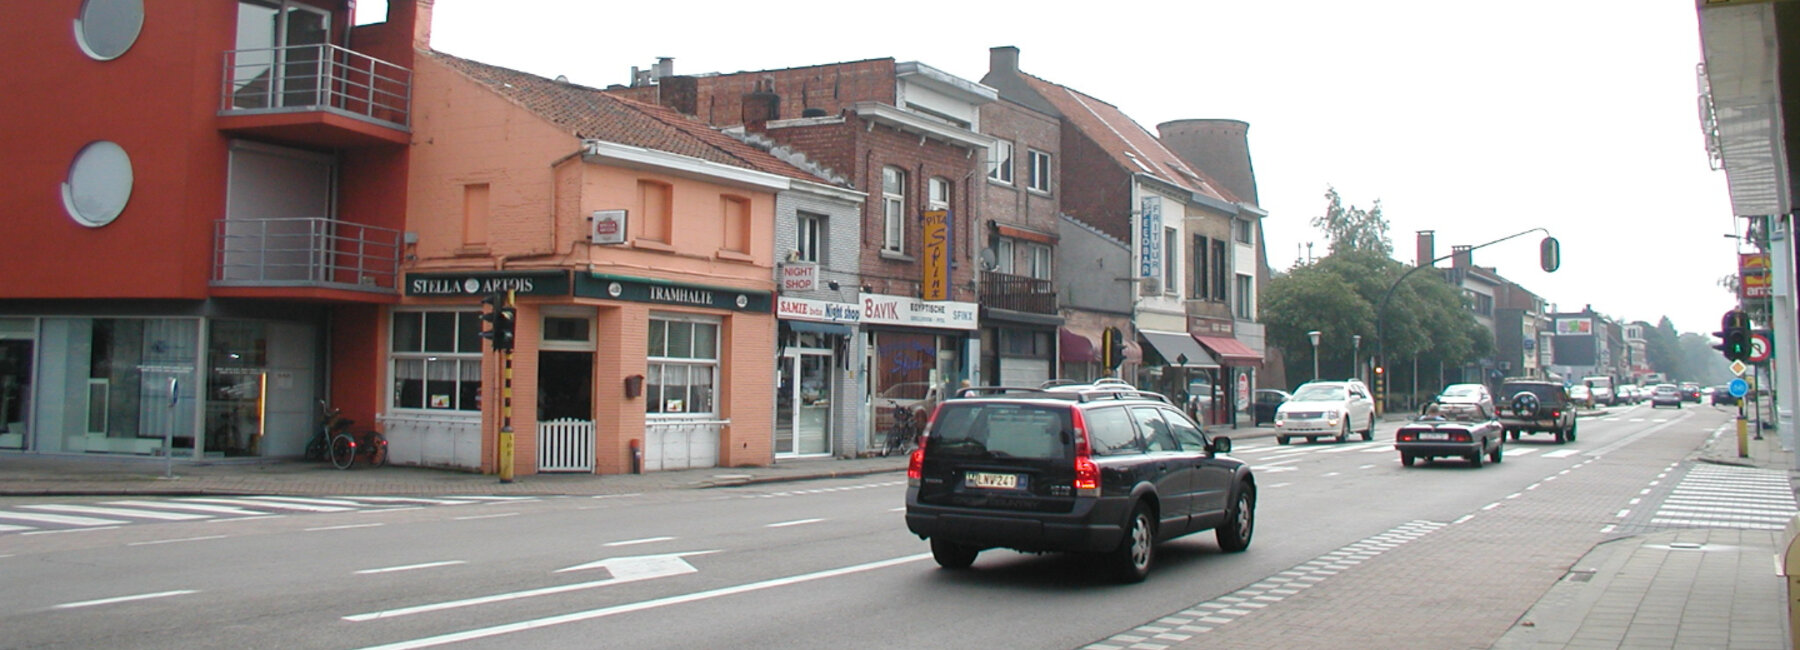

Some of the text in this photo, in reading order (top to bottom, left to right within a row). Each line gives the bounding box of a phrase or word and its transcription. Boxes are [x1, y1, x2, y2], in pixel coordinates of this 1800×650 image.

[1152, 204, 1160, 267] FRITUUR
[784, 267, 813, 277] NIGHT
[413, 278, 533, 293] STELLA ARTOIS
[785, 279, 812, 289] SHOP
[649, 286, 713, 305] TRAMHALTE
[780, 301, 808, 315] SAMIE
[825, 303, 843, 321] Night
[844, 306, 860, 321] shop
[864, 298, 899, 320] BAVIK
[910, 302, 945, 314] EGYPTISCHE
